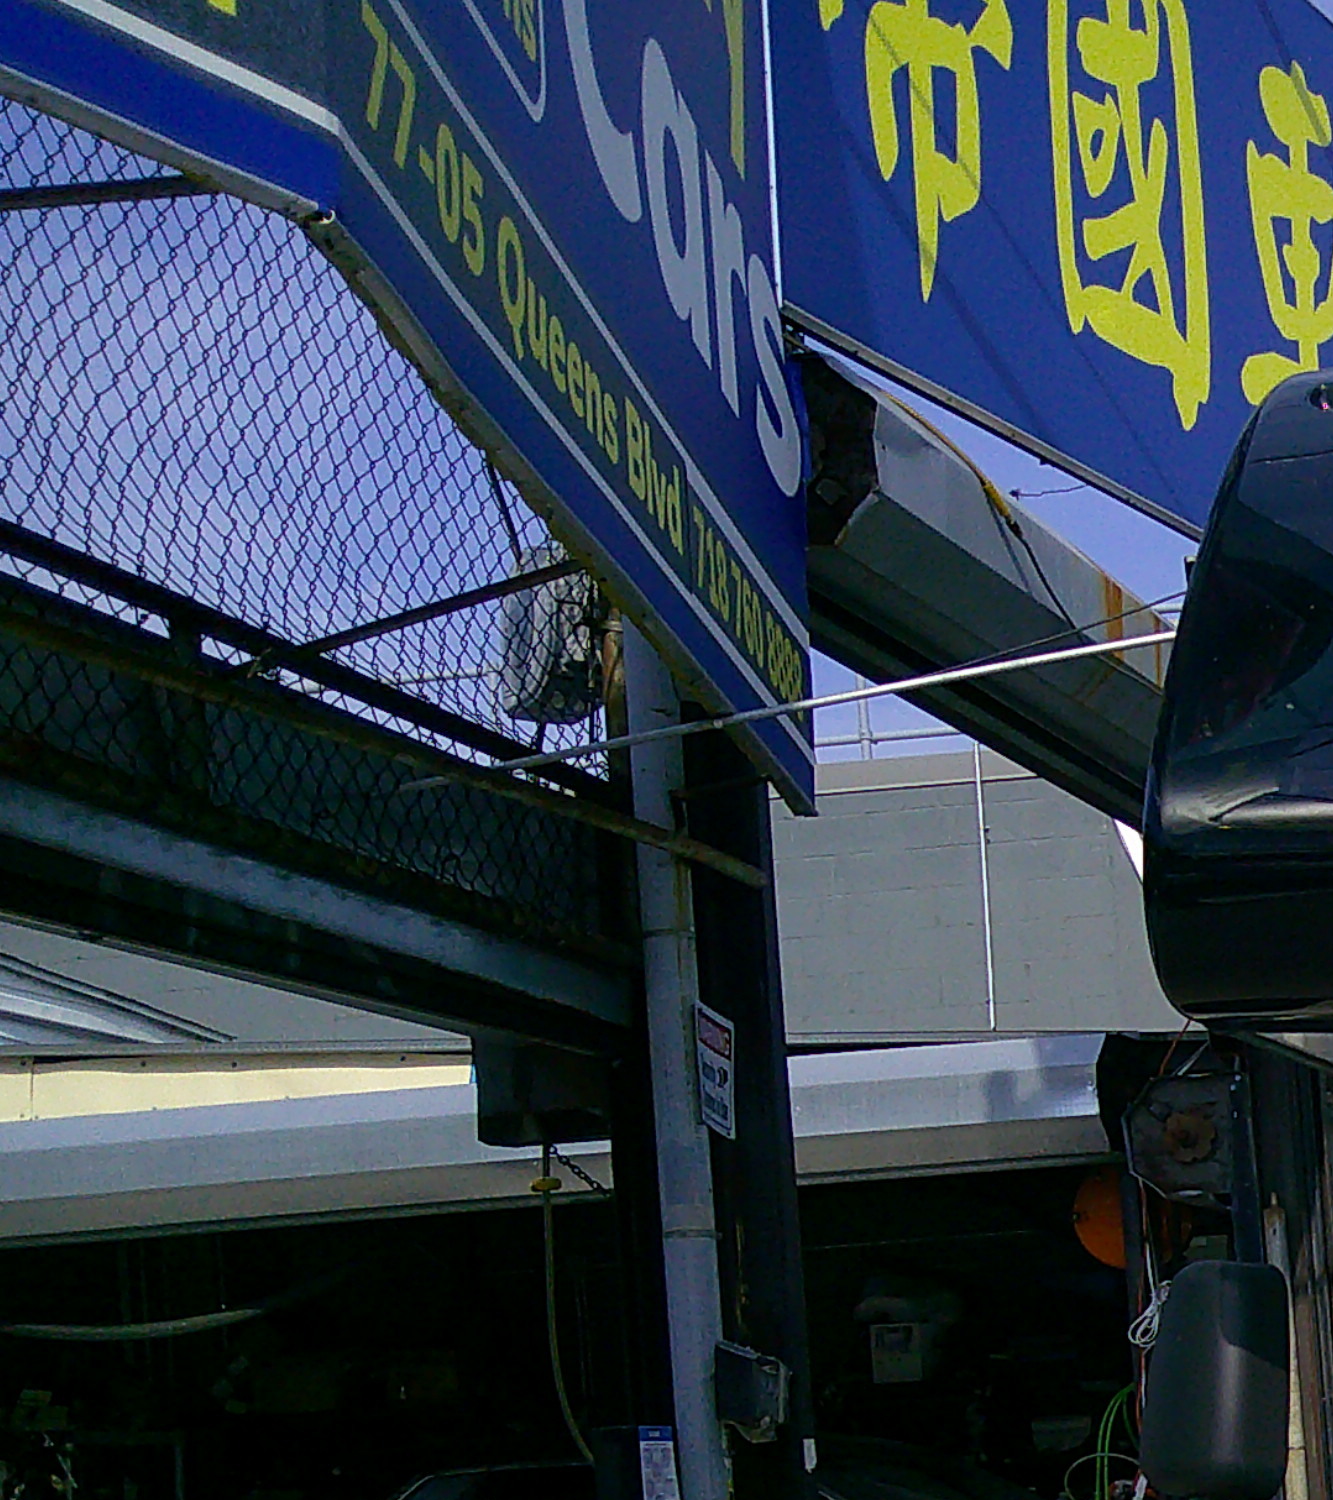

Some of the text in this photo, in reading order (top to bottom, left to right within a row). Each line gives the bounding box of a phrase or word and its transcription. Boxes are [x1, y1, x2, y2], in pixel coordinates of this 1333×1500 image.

[361, 0, 486, 277] 77-05
[497, 216, 620, 466] Queens
[625, 397, 685, 556] Blvd
[693, 505, 731, 622] 718
[730, 561, 765, 668] 760
